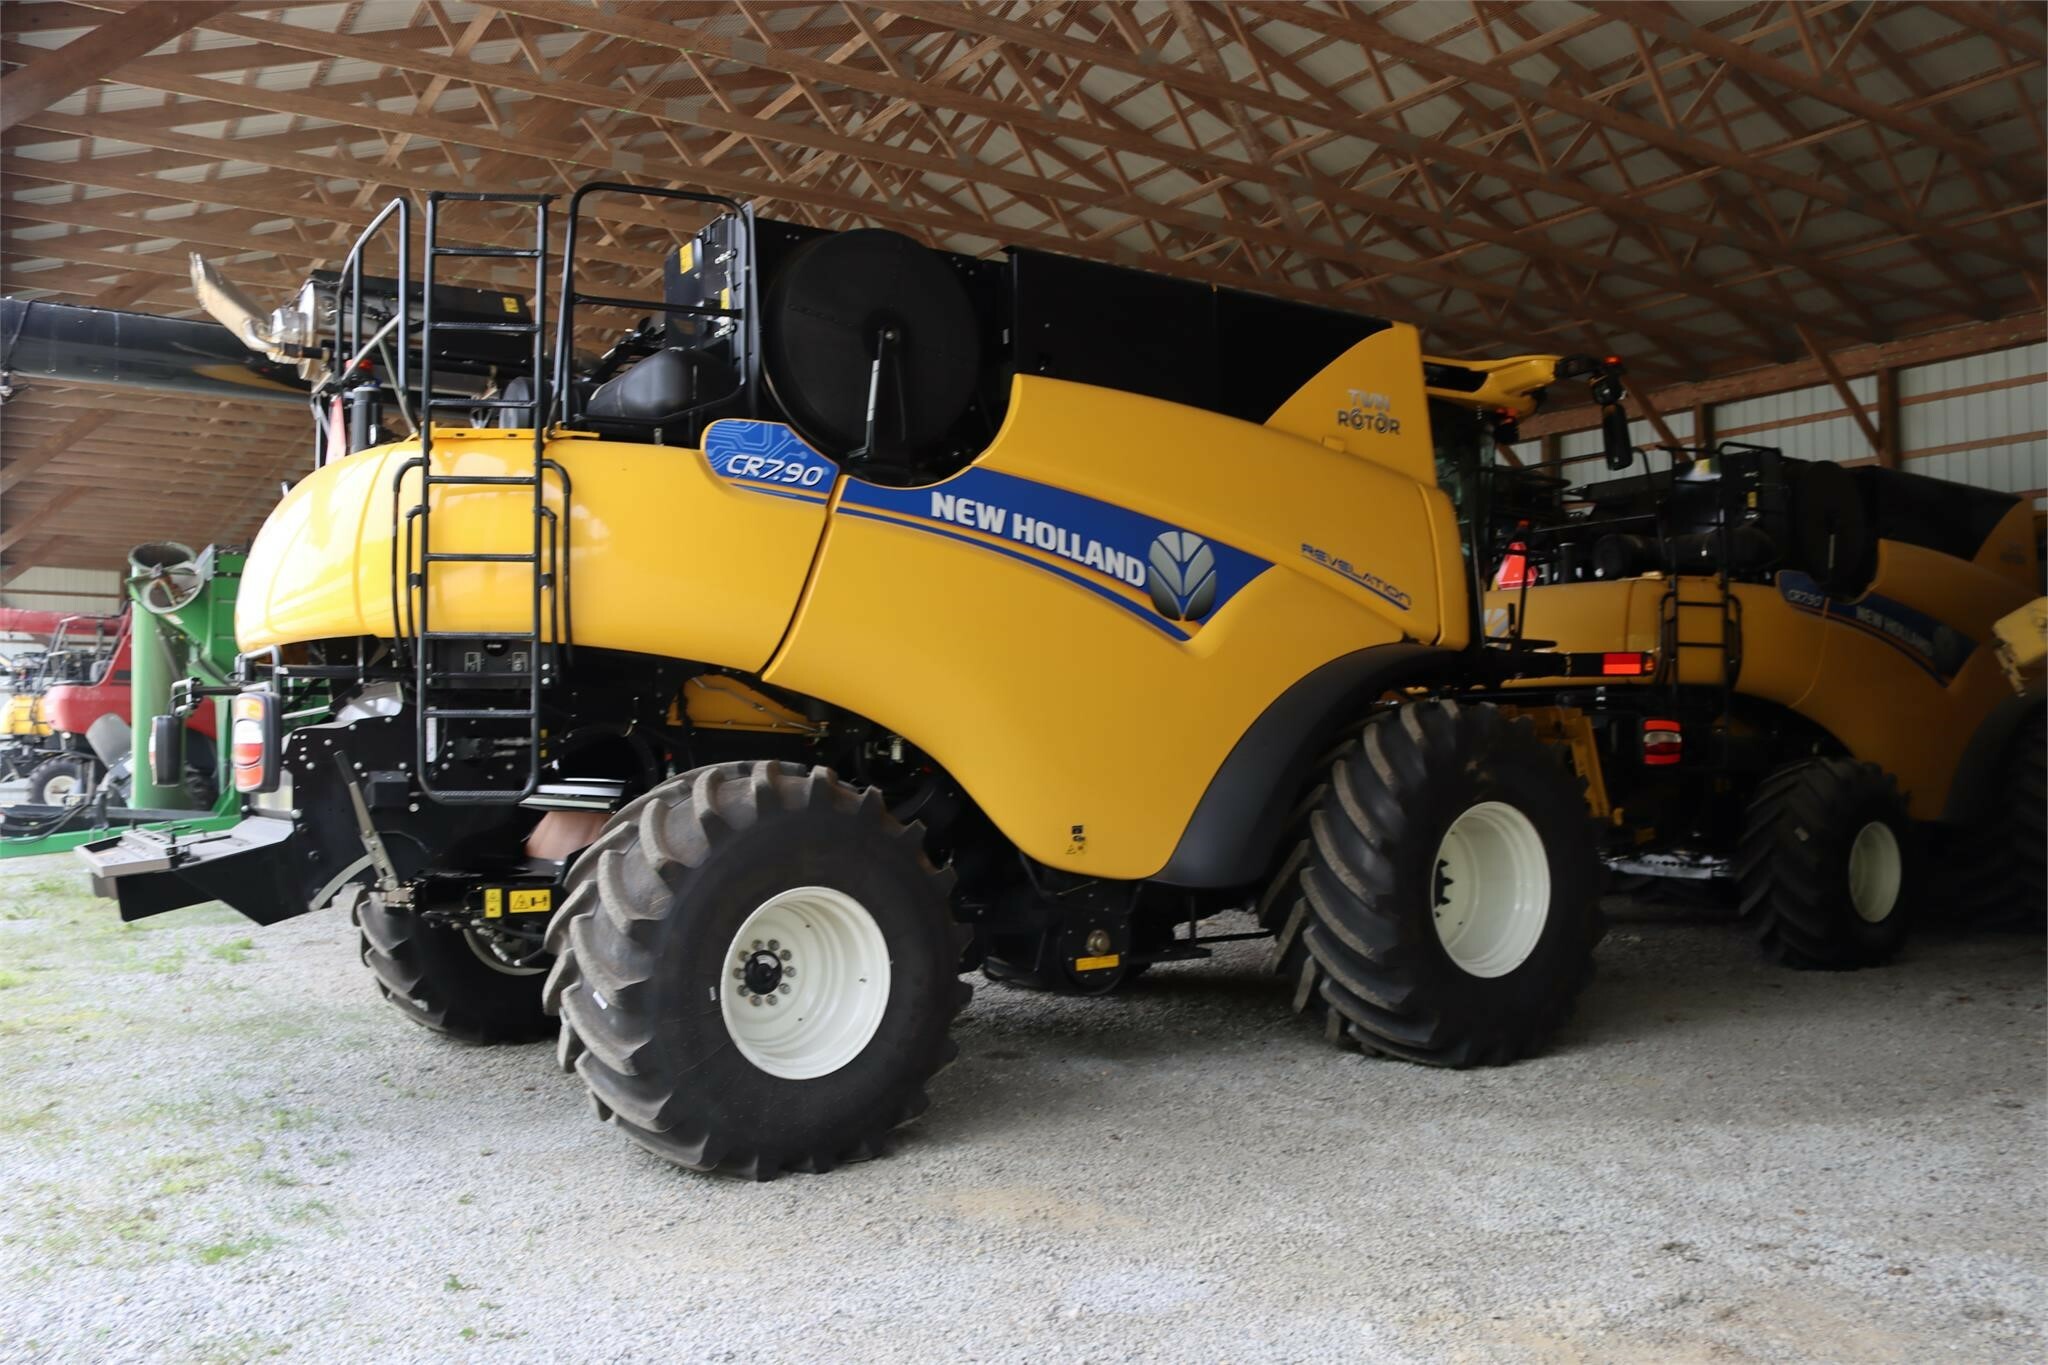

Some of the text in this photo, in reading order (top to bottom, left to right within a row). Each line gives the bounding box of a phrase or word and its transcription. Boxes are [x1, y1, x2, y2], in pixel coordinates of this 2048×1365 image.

[1337, 407, 1401, 436] ROTOR
[726, 454, 824, 486] CR7.90
[931, 491, 1147, 588] NEW HOLLAND
[1301, 543, 1412, 607] REVELATION
